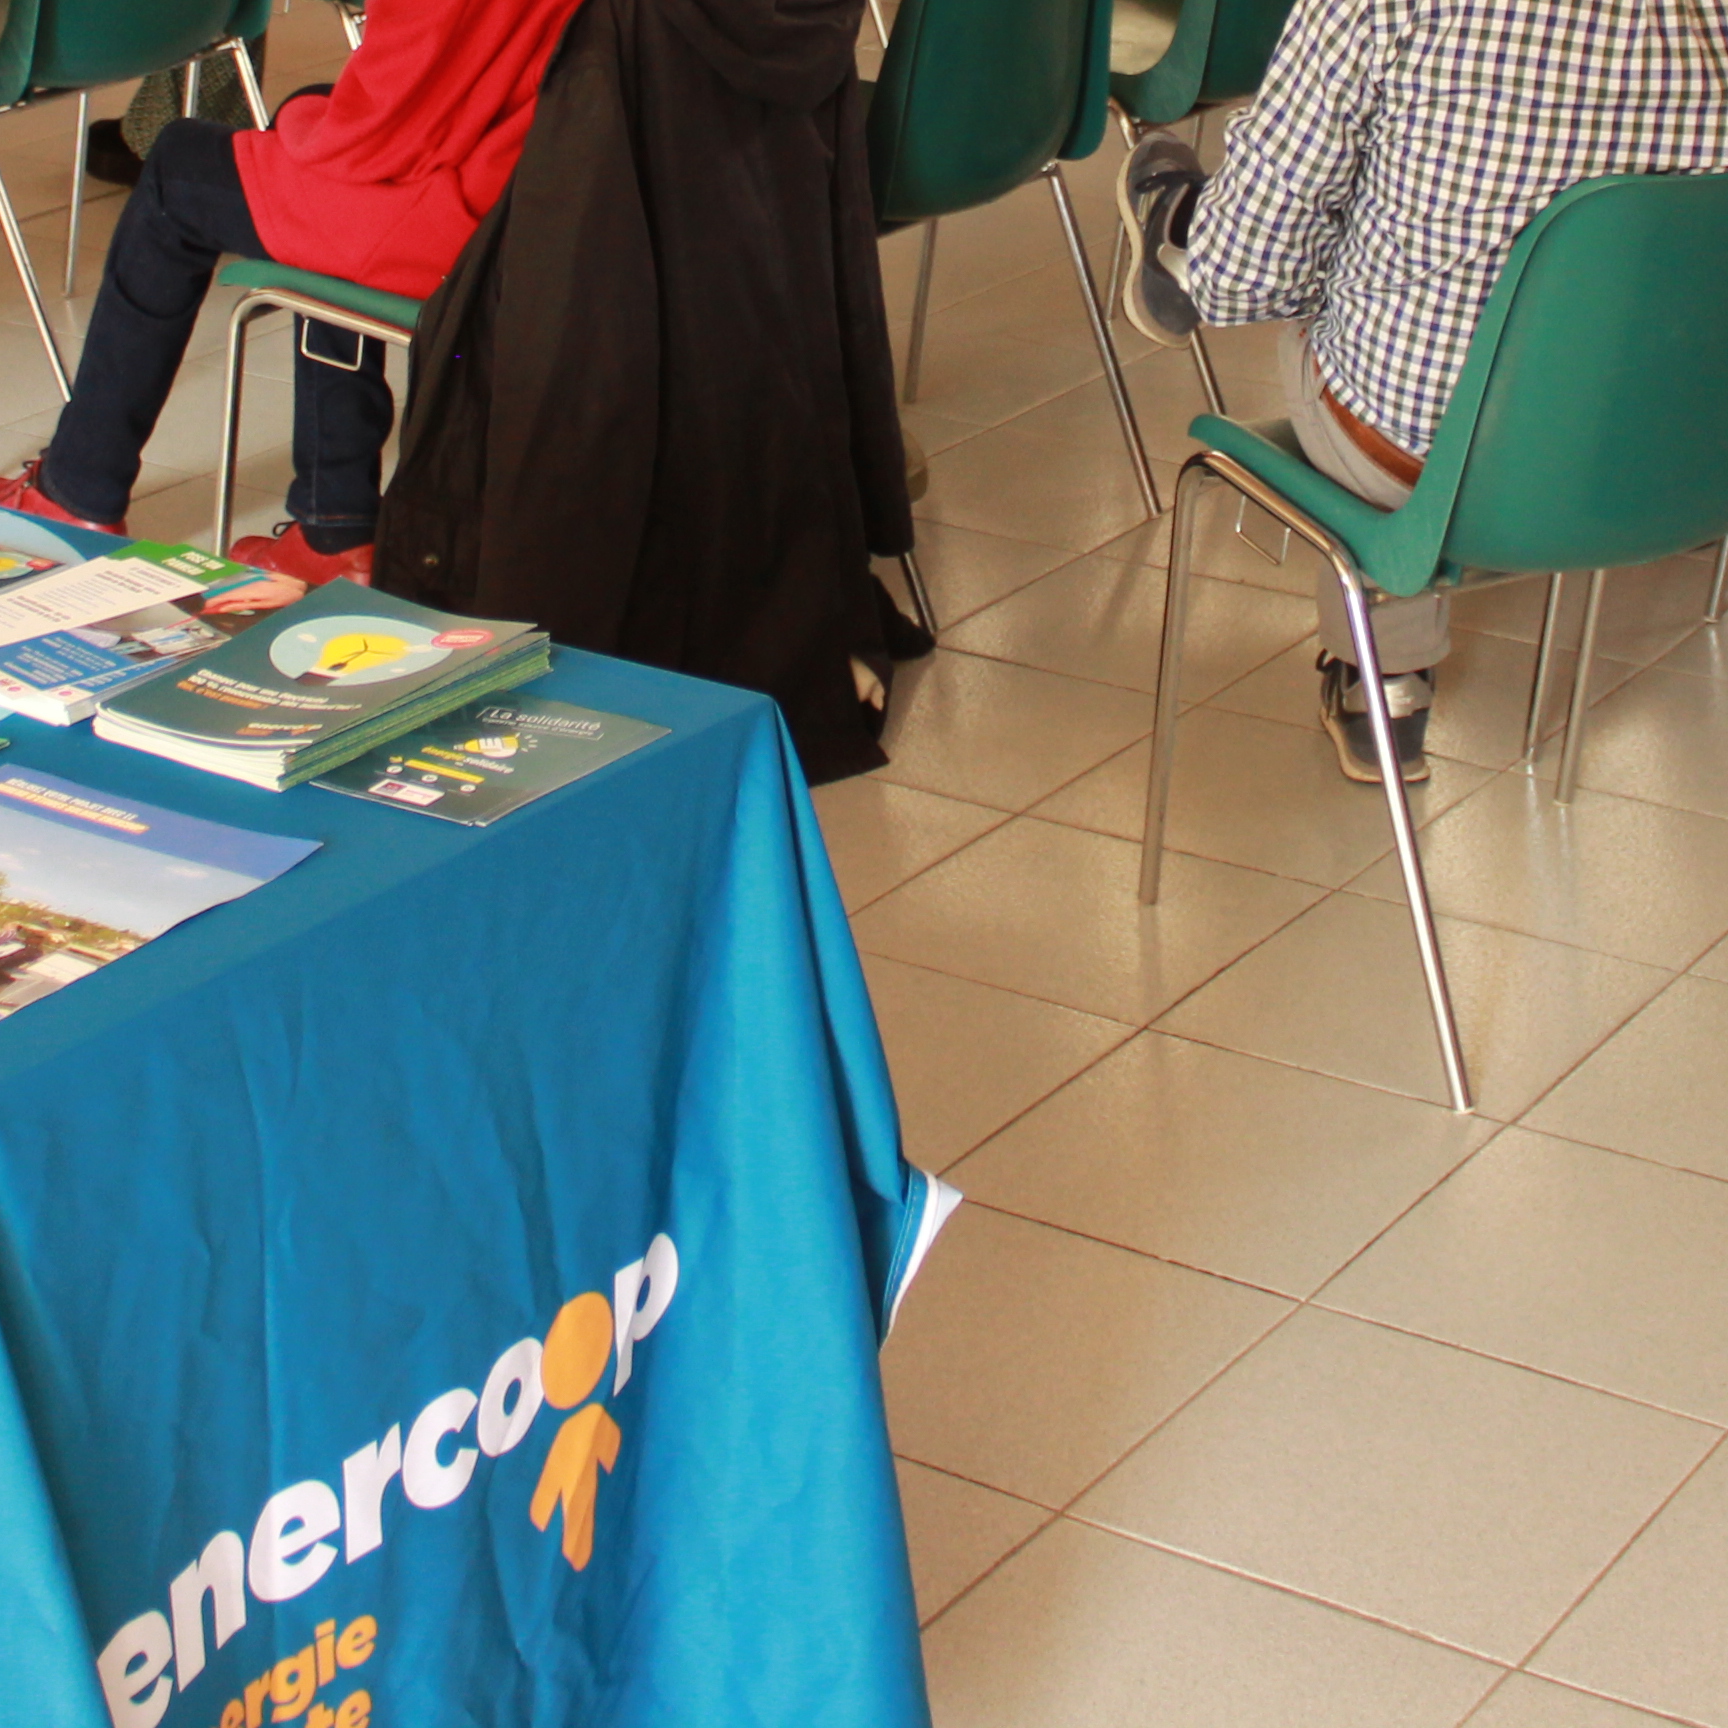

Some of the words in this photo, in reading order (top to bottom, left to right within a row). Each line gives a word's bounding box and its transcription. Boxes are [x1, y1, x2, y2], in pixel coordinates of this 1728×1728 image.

[489, 708, 512, 720] La
[515, 711, 602, 731] solidarité
[95, 1232, 680, 1728] enercoop
[218, 1614, 378, 1728] ergie
